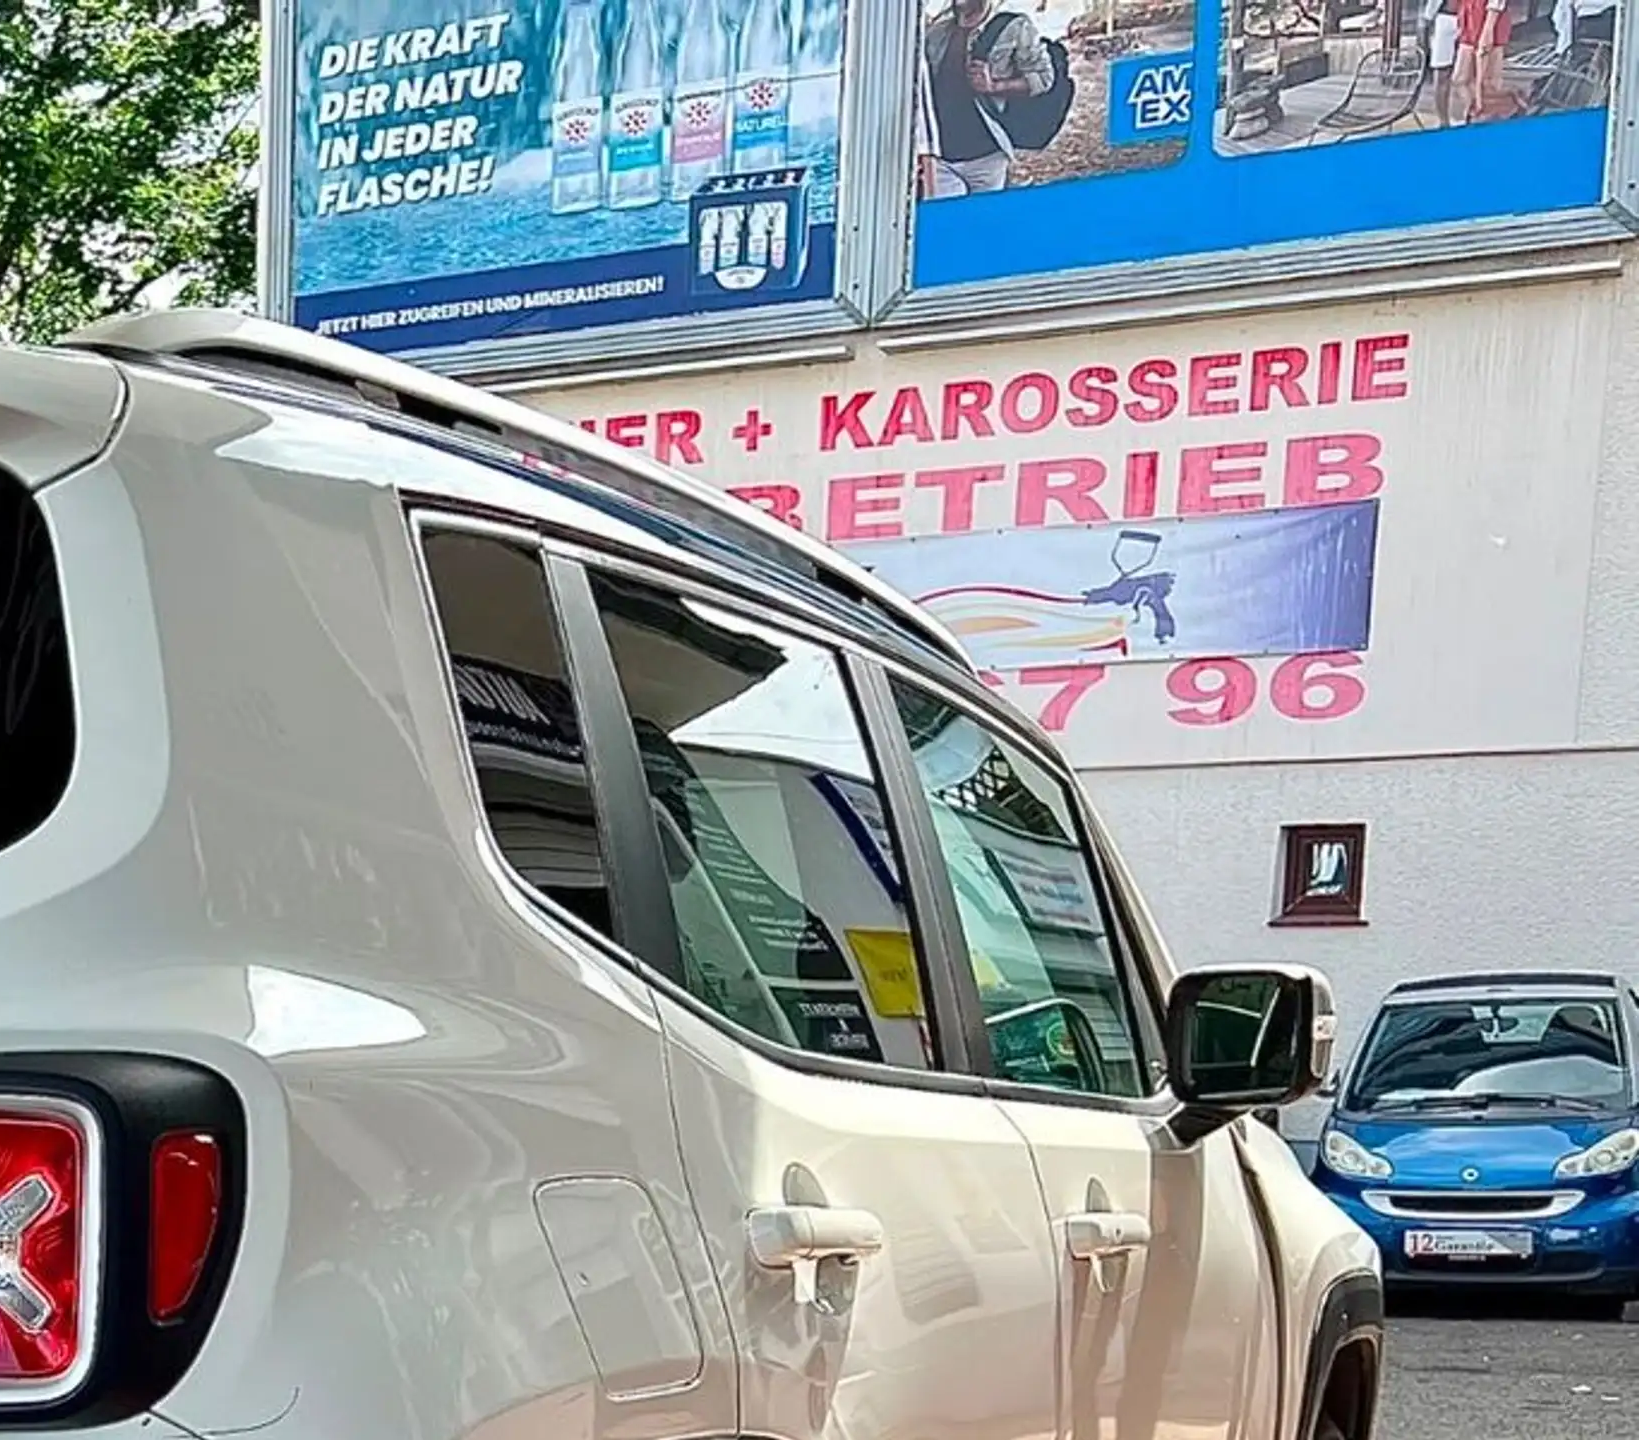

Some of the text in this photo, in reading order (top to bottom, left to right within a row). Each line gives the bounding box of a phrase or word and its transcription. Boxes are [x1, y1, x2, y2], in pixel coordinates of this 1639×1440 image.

[320, 14, 511, 78] DIE KRAFT
[318, 61, 523, 126] DER NATUR
[1136, 91, 1191, 129] EX
[318, 115, 479, 170] IN JEDER
[317, 155, 495, 216] FLASCHE!
[318, 275, 665, 336] JETZT HIER ZUGREIFEN UND MINERALISIEREN!
[819, 334, 1411, 451] KAROSSERIE
[1166, 650, 1364, 726] 96
[1409, 1233, 1434, 1252] 12
